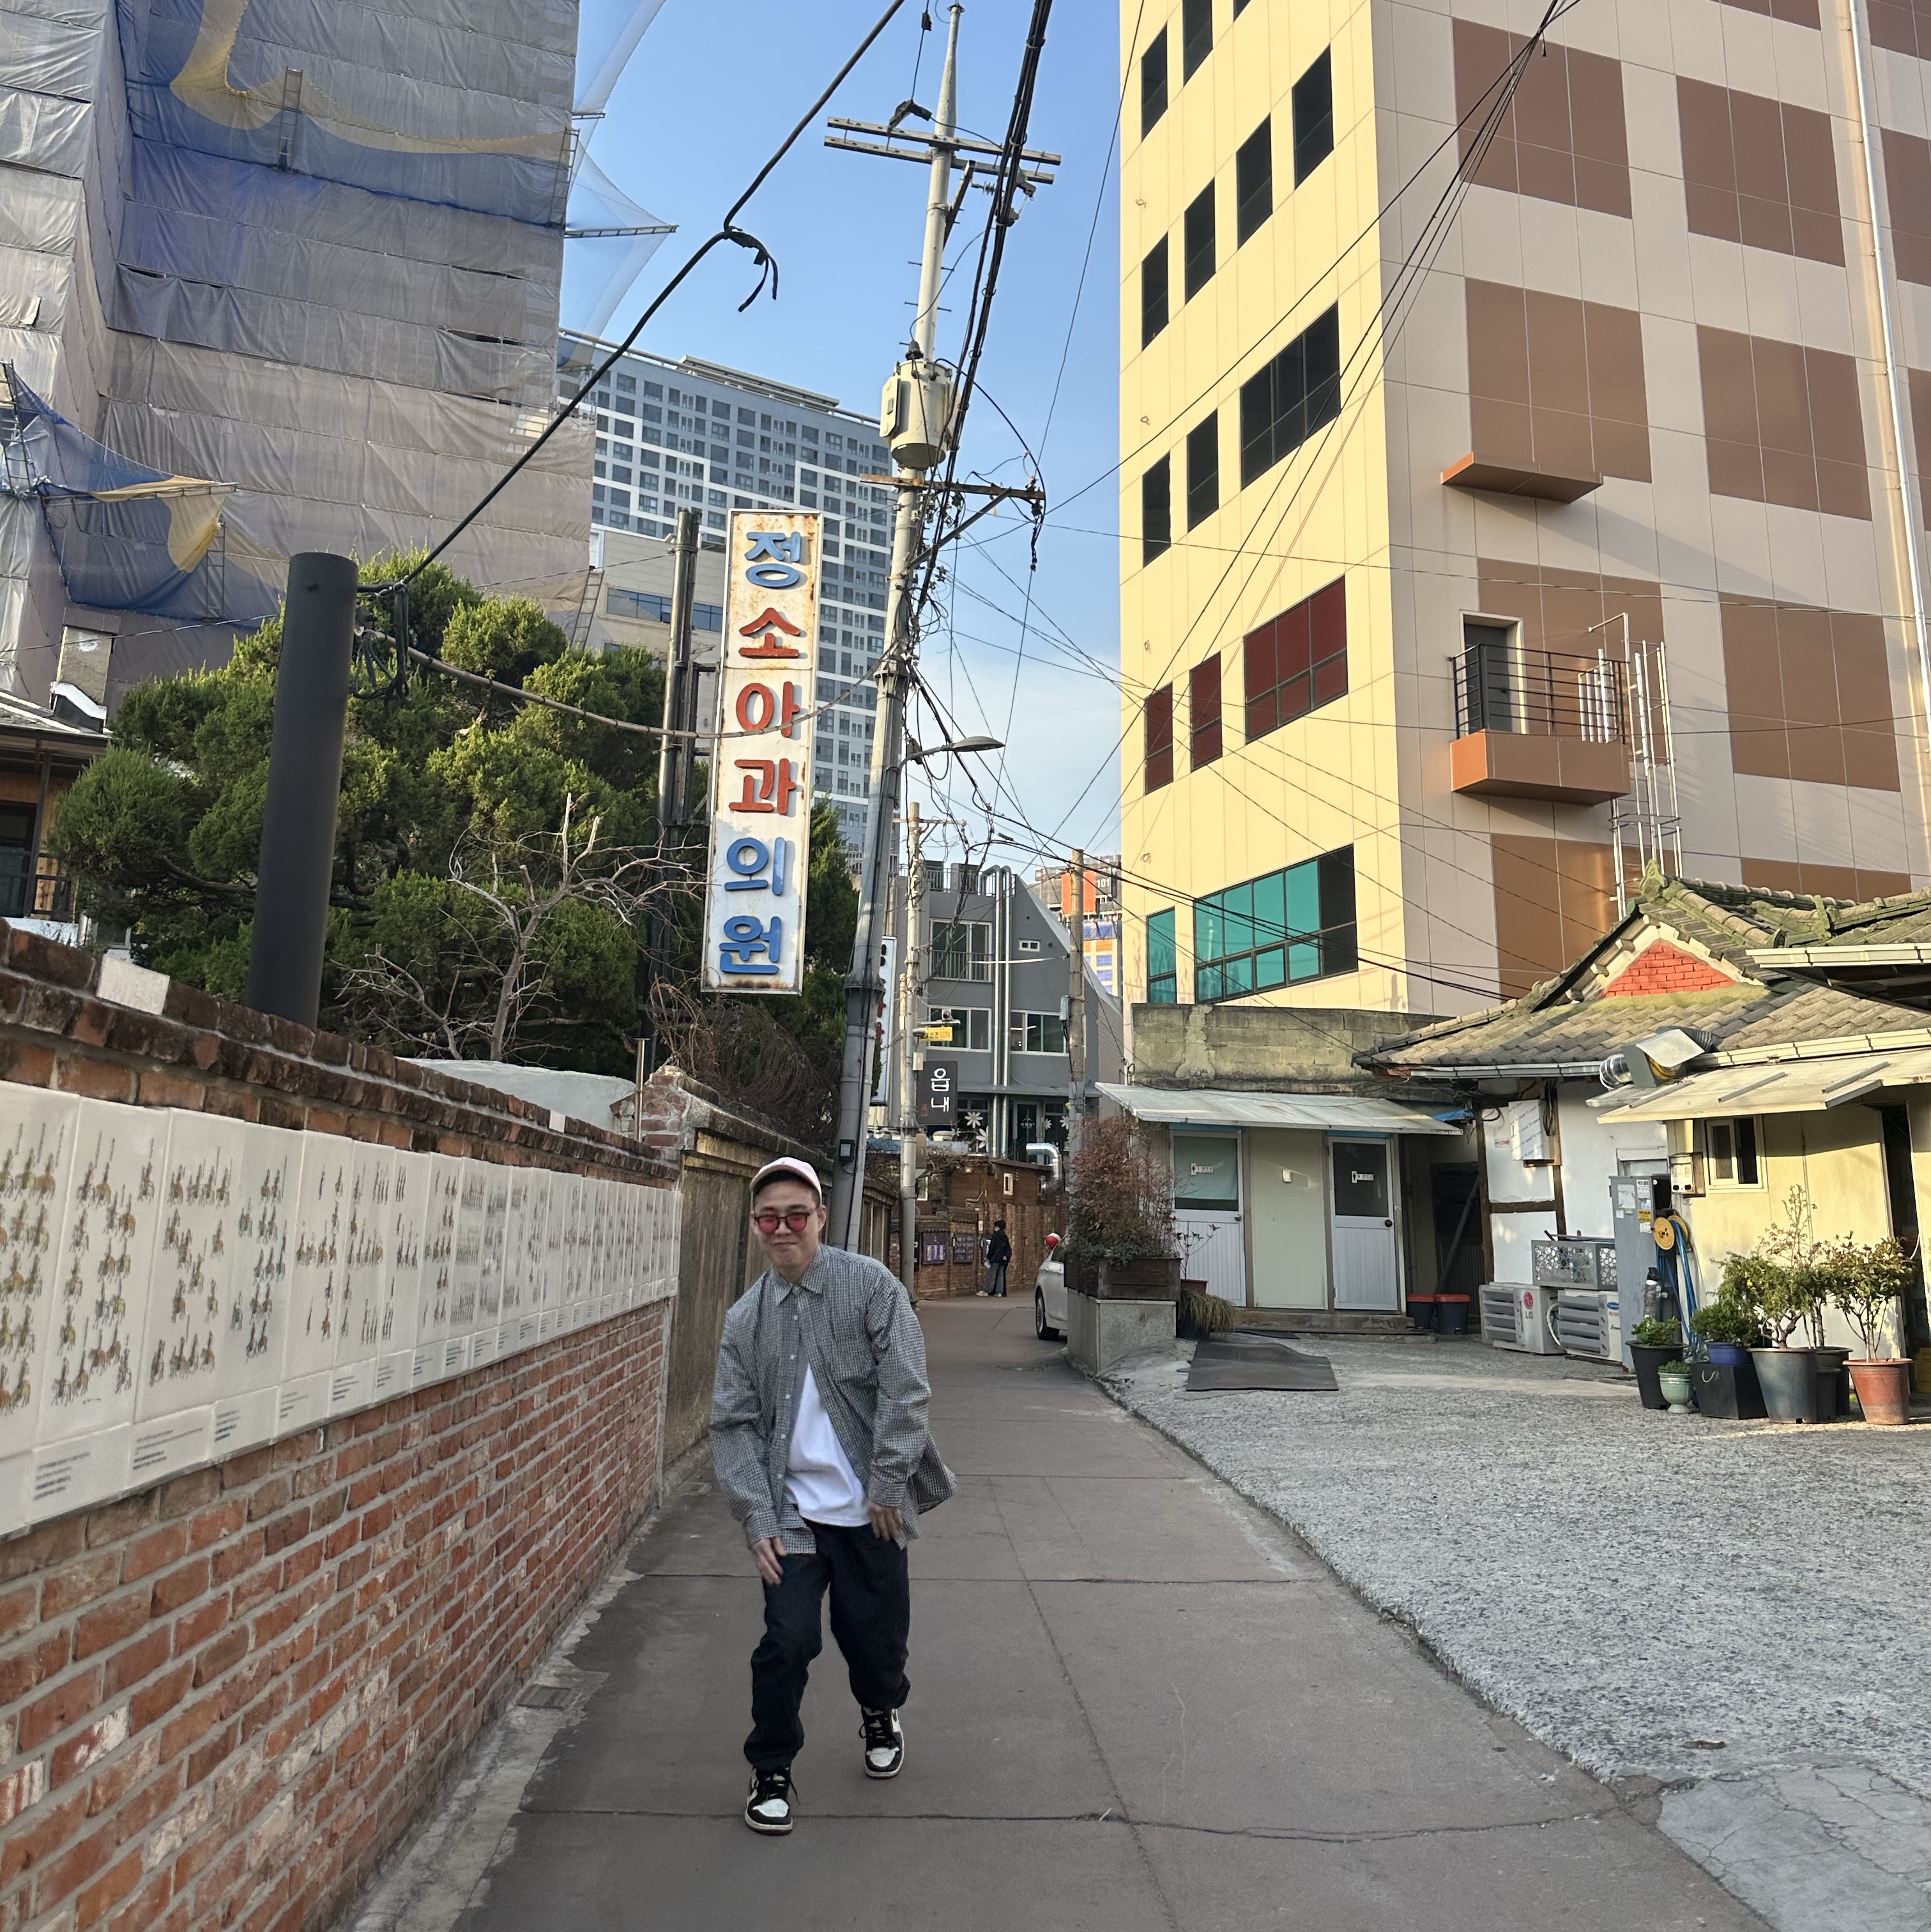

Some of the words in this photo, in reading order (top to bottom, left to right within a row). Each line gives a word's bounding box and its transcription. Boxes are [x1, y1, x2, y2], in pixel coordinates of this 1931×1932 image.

[719, 531, 801, 975] 정소아과의원
[1097, 878, 1110, 888] 101
[930, 1068, 950, 1112] 읍내
[1525, 1311, 1534, 1320] LG
